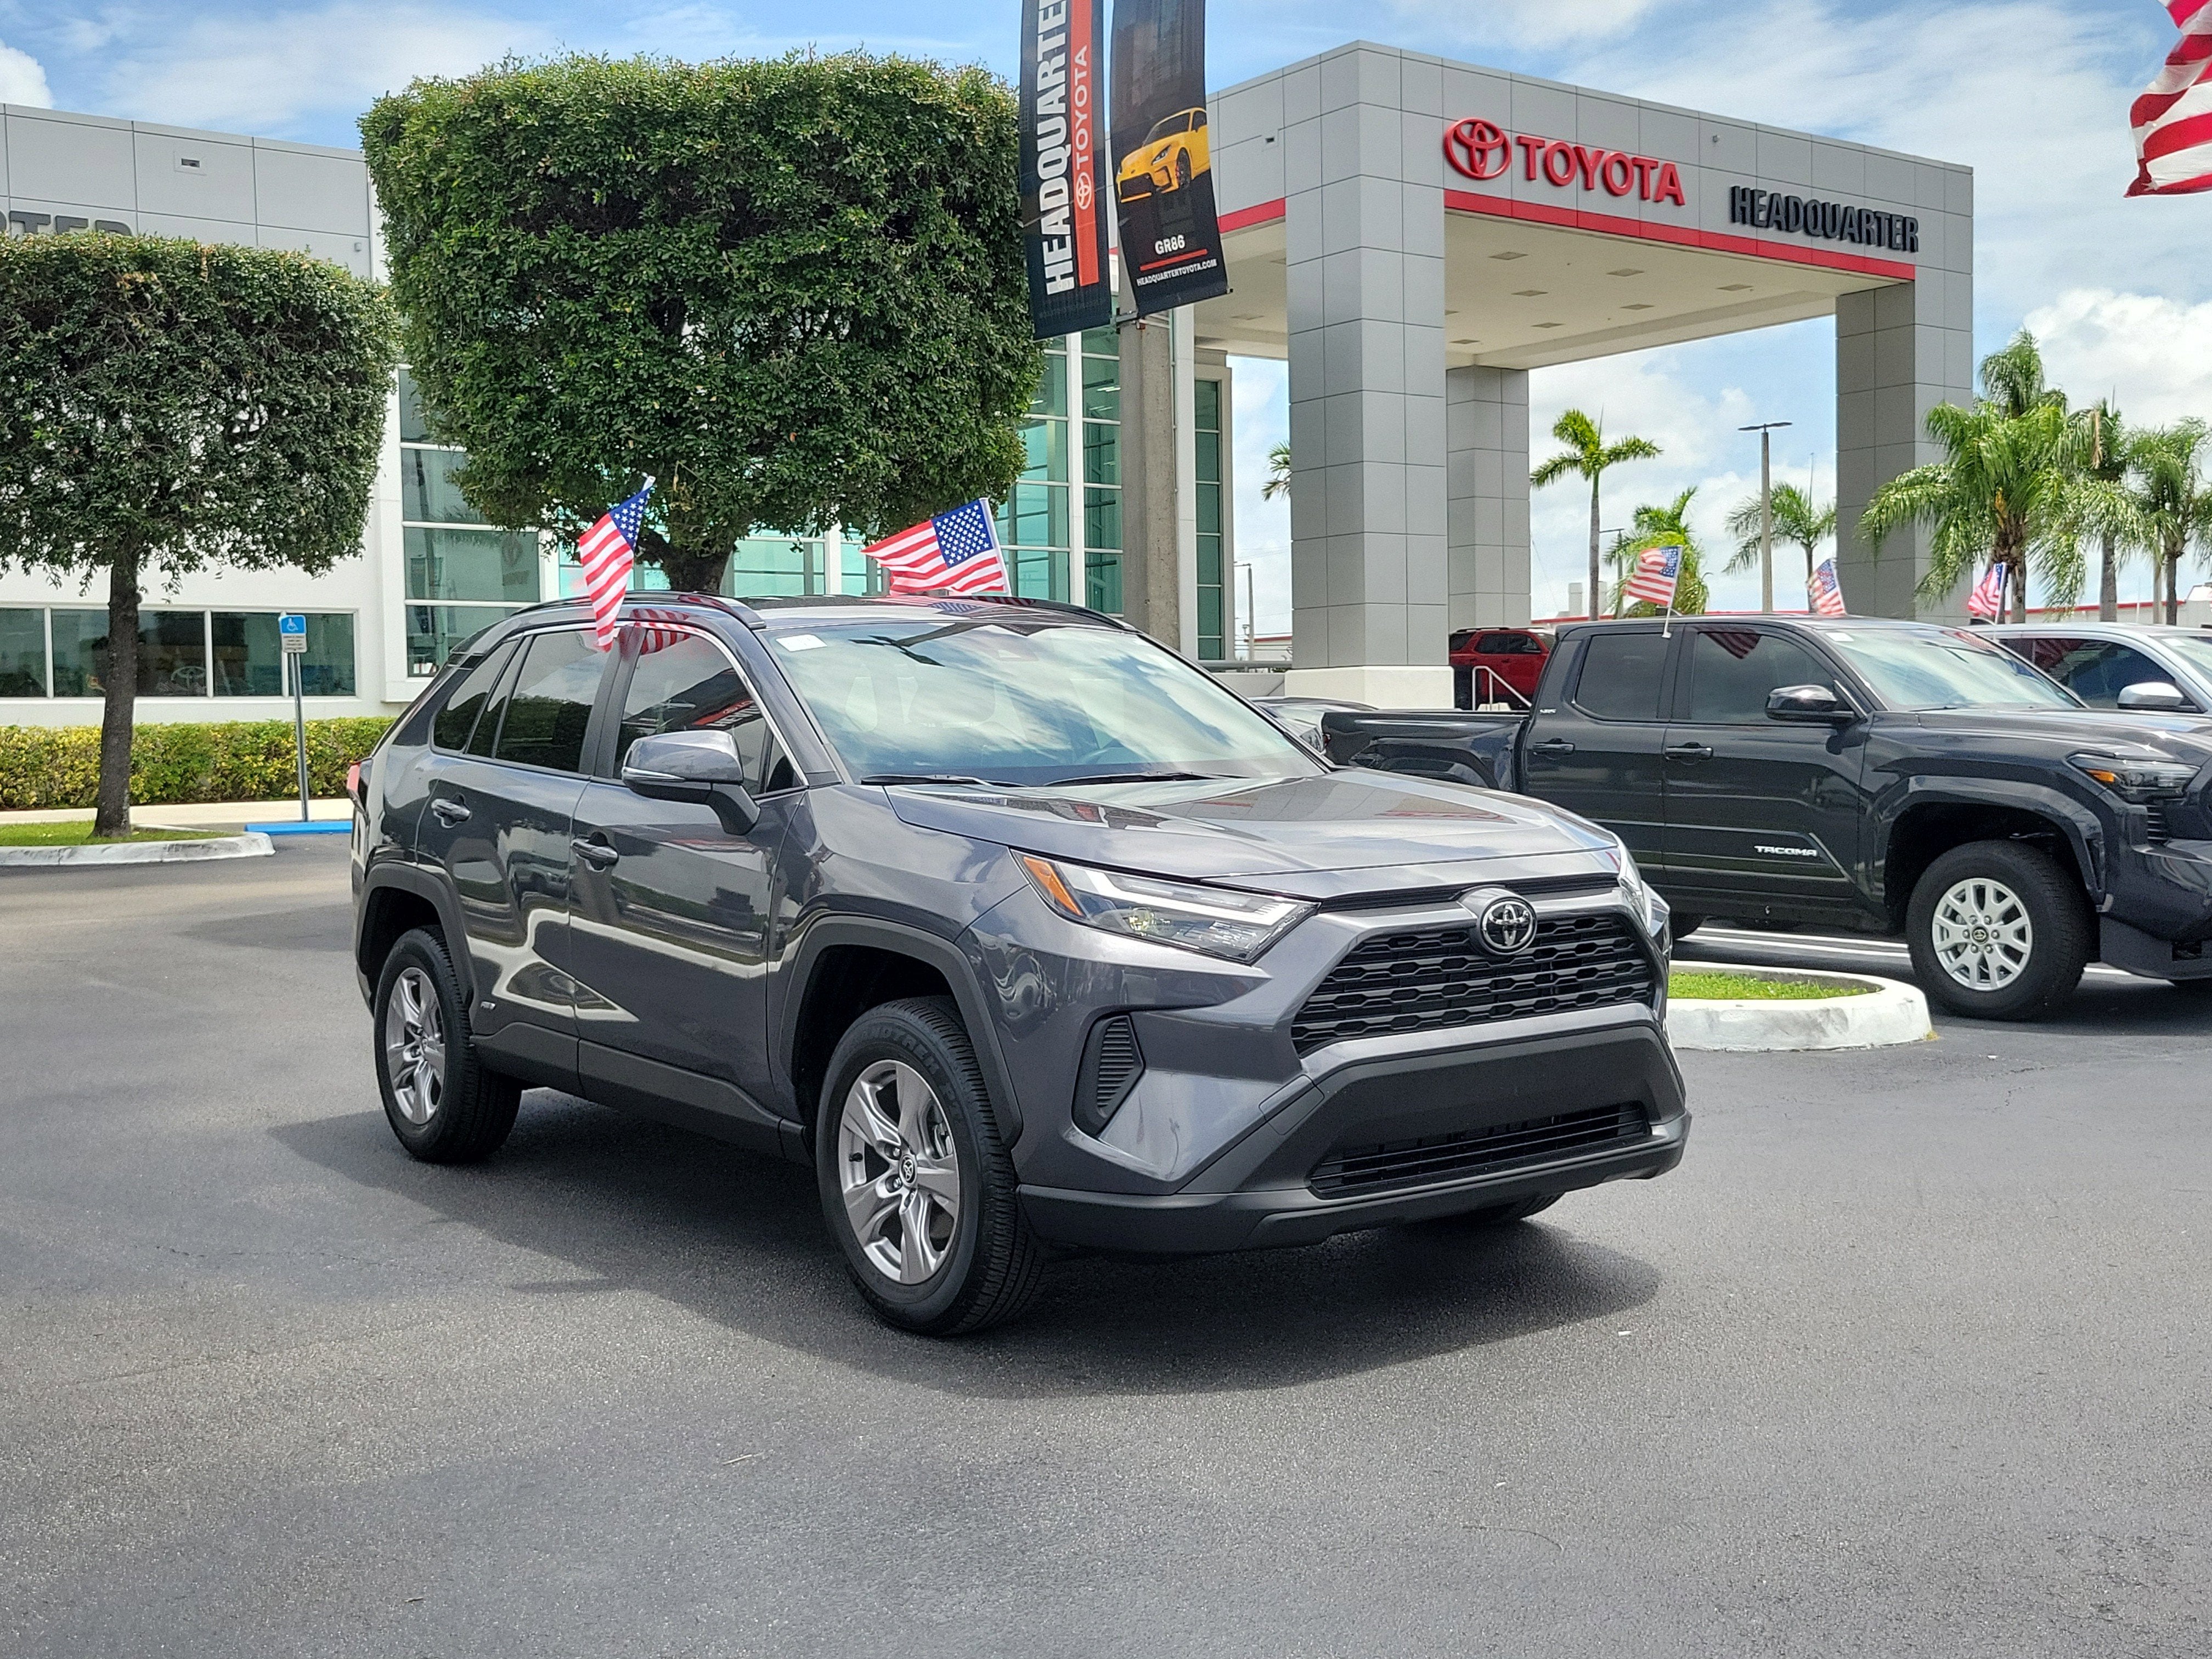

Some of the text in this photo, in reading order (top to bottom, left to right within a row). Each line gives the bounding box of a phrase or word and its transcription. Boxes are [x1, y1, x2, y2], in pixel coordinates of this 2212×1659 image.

[1074, 45, 1089, 171] TOYOTA
[1515, 135, 1918, 253] TOYOTA HEADQUARTER
[1154, 234, 1186, 255] GR86
[1136, 258, 1218, 287] HEADQUARTERTOYOTA.COM
[1753, 845, 1818, 857] TACOMA
